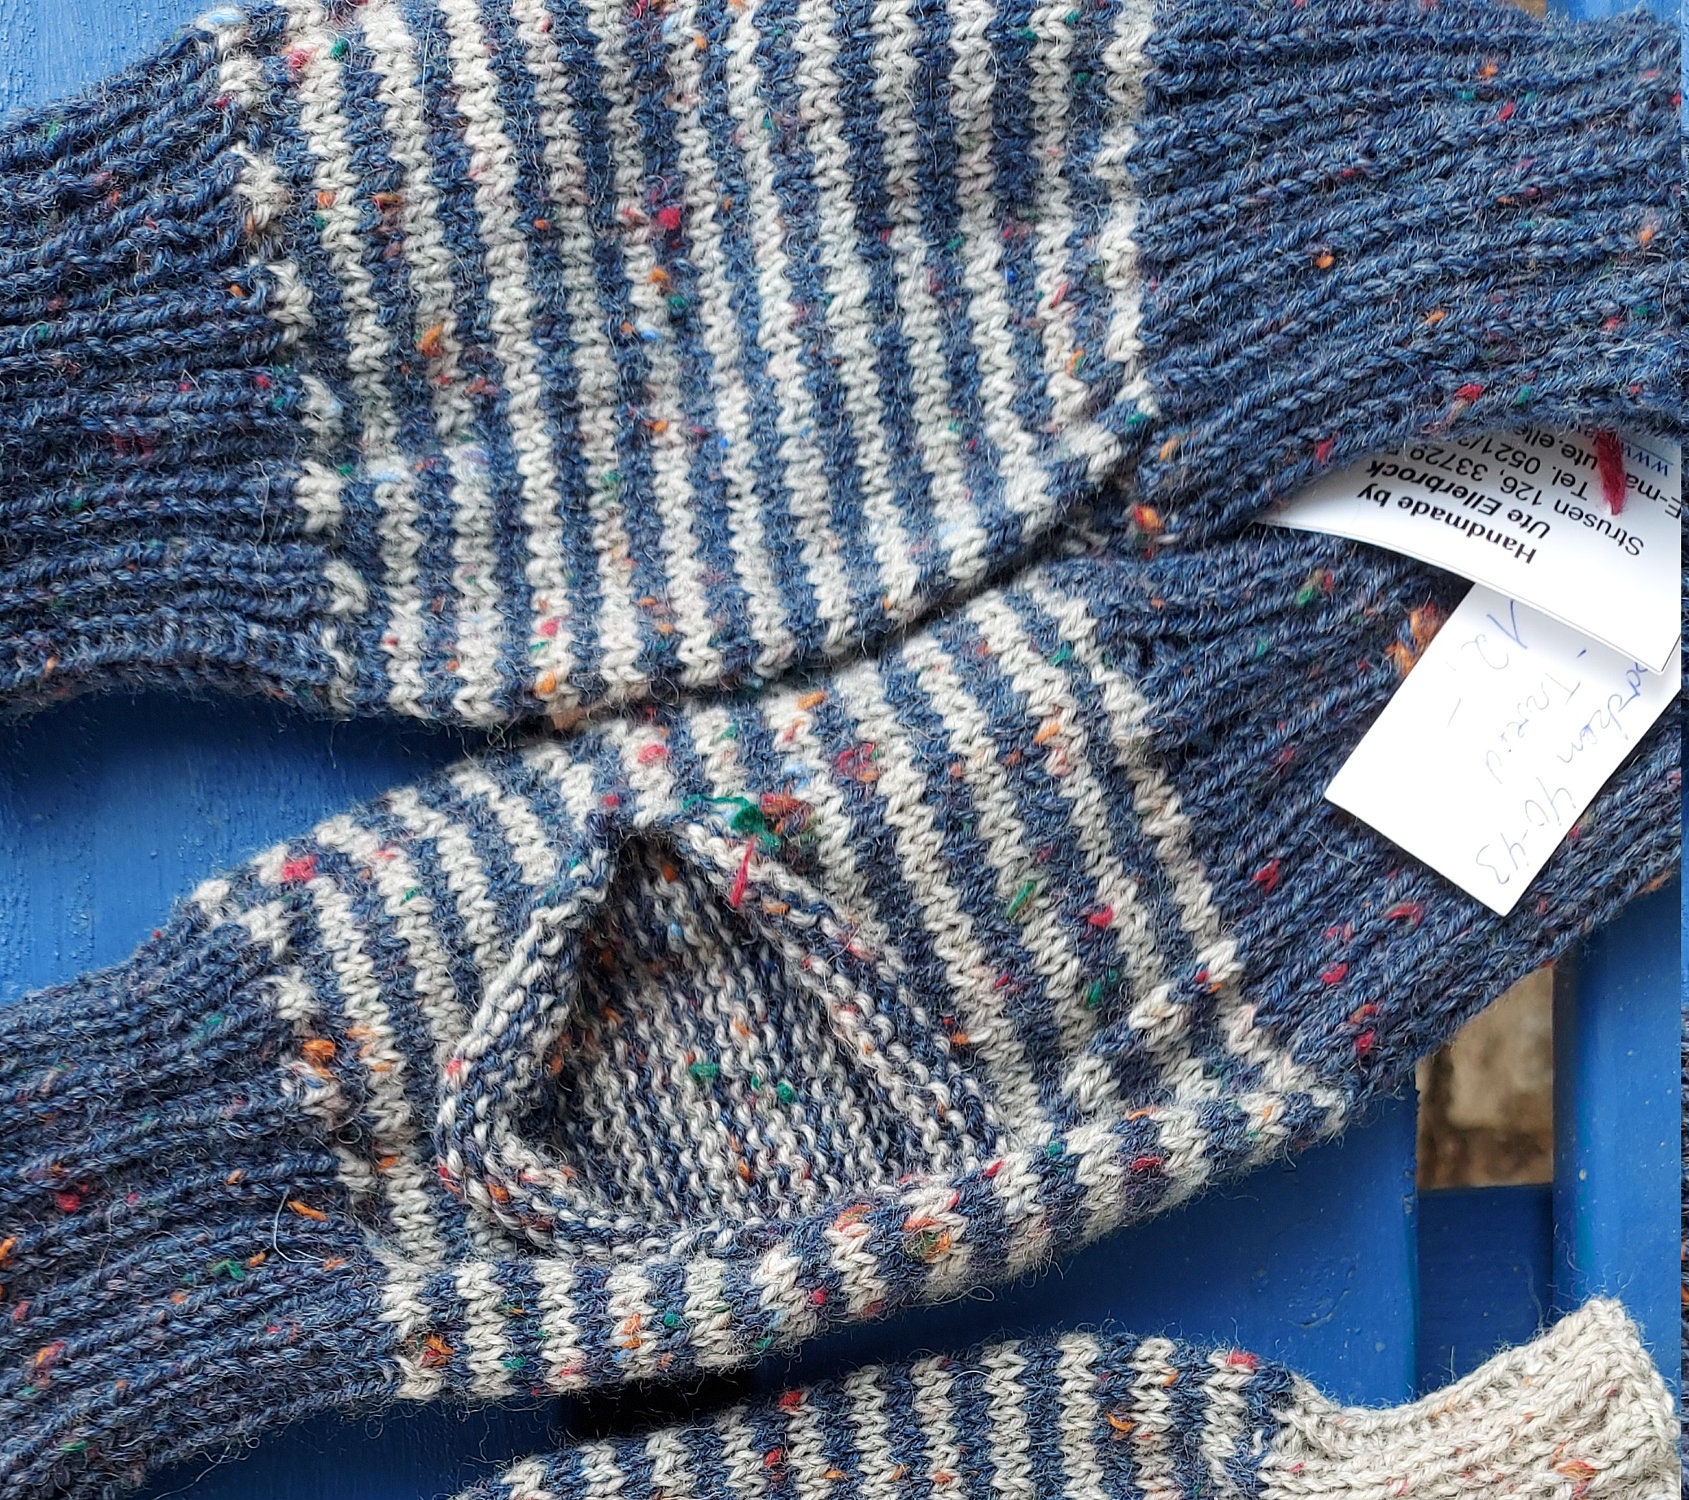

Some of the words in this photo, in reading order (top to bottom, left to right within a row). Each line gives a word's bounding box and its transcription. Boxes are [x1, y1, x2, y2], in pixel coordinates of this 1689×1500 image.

[1357, 483, 1392, 508] by
[1366, 460, 1503, 517] Ellerbrock
[1500, 469, 1543, 506] 126,
[1551, 465, 1589, 501] Tel.
[1625, 471, 1681, 519] E-ma
[1398, 496, 1537, 565] Handmade
[1507, 508, 1551, 540] Ute
[1554, 499, 1645, 556] Strusen
[1475, 776, 1577, 885] 40-43
